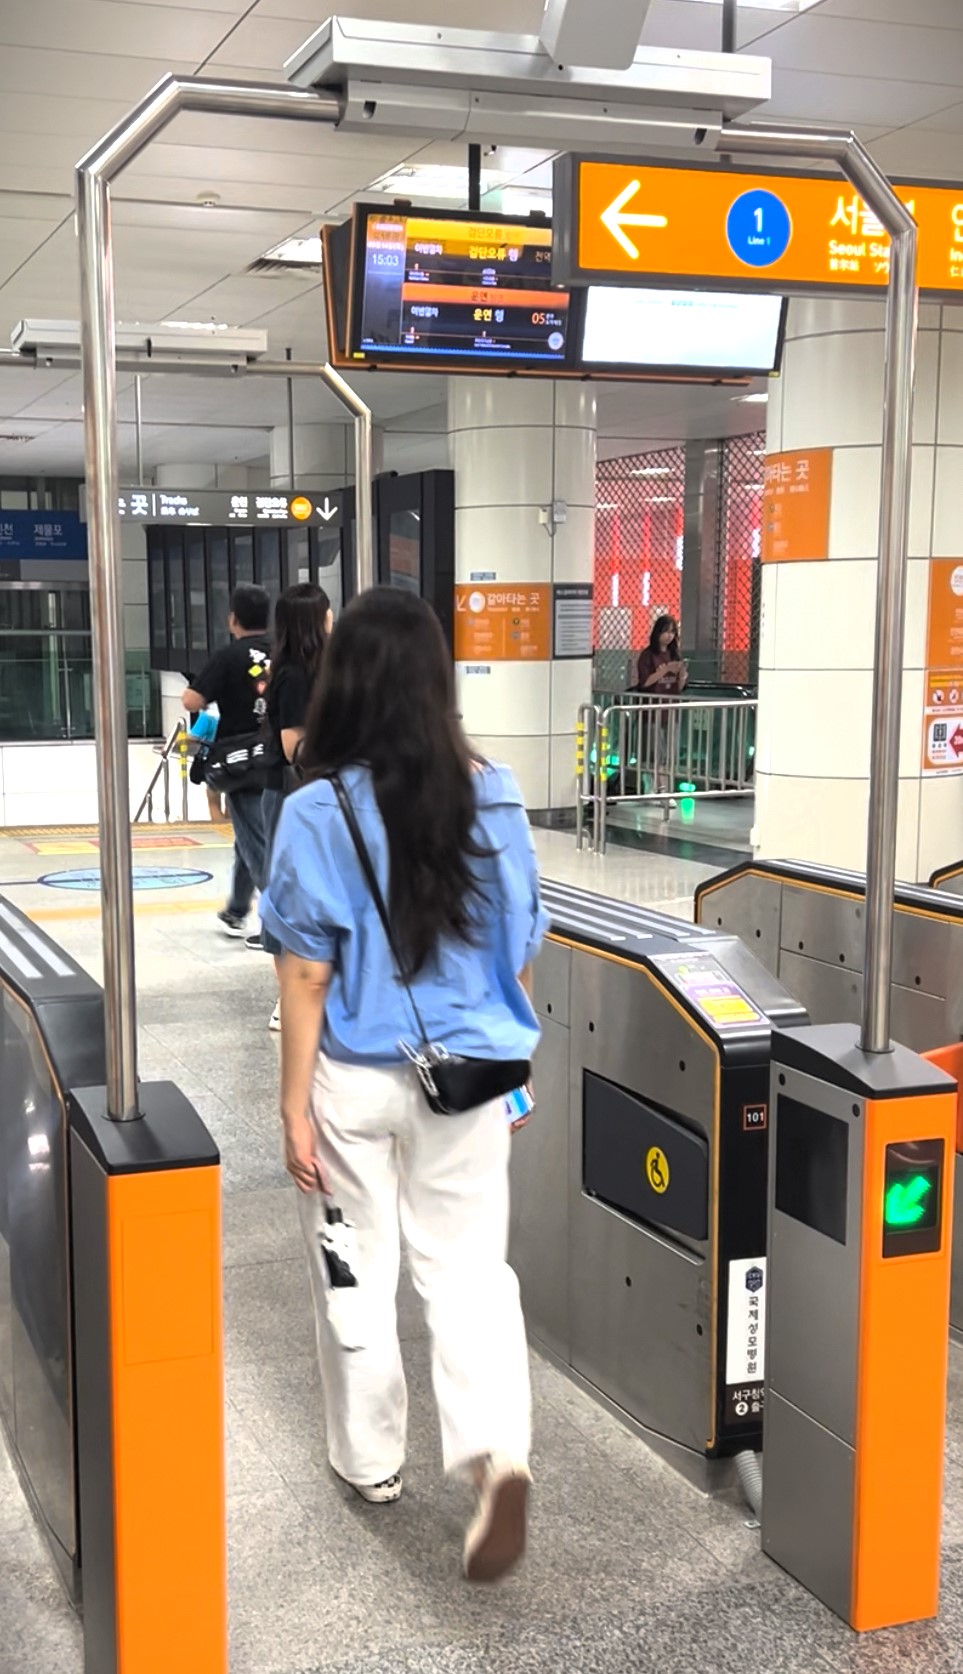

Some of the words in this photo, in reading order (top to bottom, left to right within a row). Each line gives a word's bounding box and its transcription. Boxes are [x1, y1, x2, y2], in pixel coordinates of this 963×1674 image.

[753, 207, 764, 232] 1
[747, 235, 765, 245] Line
[766, 236, 771, 246] 1
[828, 239, 866, 257] Seoul
[372, 253, 399, 266] 15:03
[473, 308, 493, 321] 운연
[531, 312, 545, 325] 05
[796, 459, 810, 481] 곳
[130, 493, 149, 516] 곳
[487, 591, 527, 606] 갈아타는
[530, 592, 541, 605] 곳
[746, 1112, 765, 1123] 101
[746, 1296, 759, 1375] 국제성모병원
